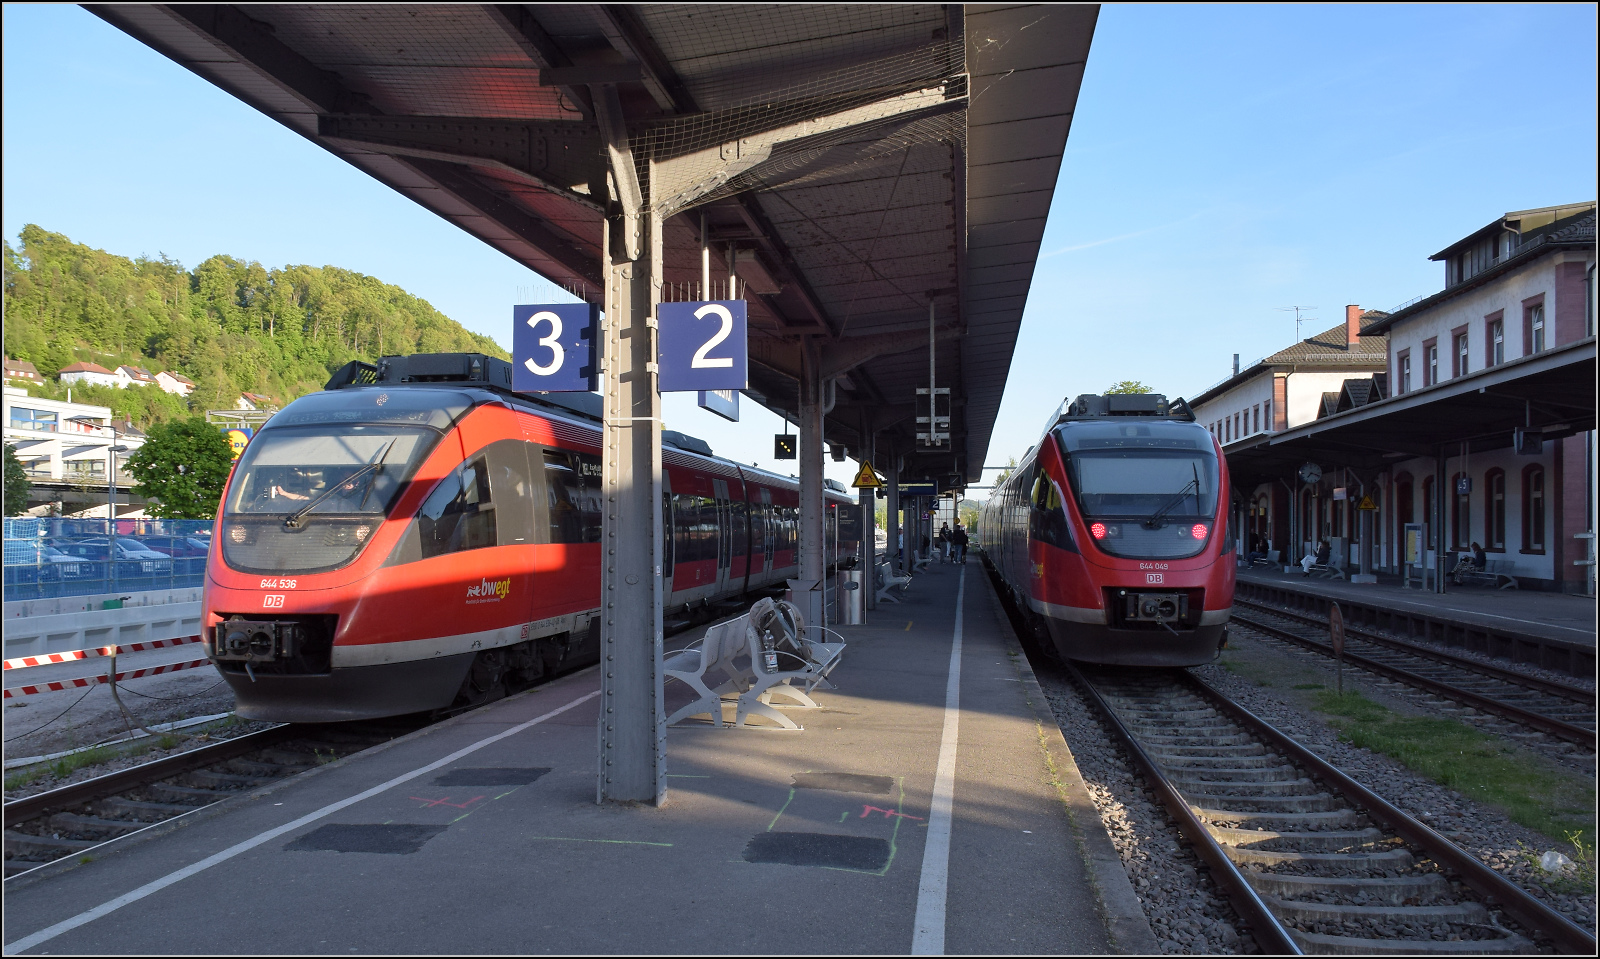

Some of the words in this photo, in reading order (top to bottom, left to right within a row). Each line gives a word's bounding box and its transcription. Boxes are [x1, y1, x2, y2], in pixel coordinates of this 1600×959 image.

[691, 304, 733, 369] 2
[524, 311, 565, 376] 3
[932, 499, 939, 509] 2
[260, 579, 277, 588] 644
[279, 579, 297, 589] 536
[1147, 574, 1163, 583] DB
[481, 577, 511, 599] bwegt
[264, 595, 284, 607] DB
